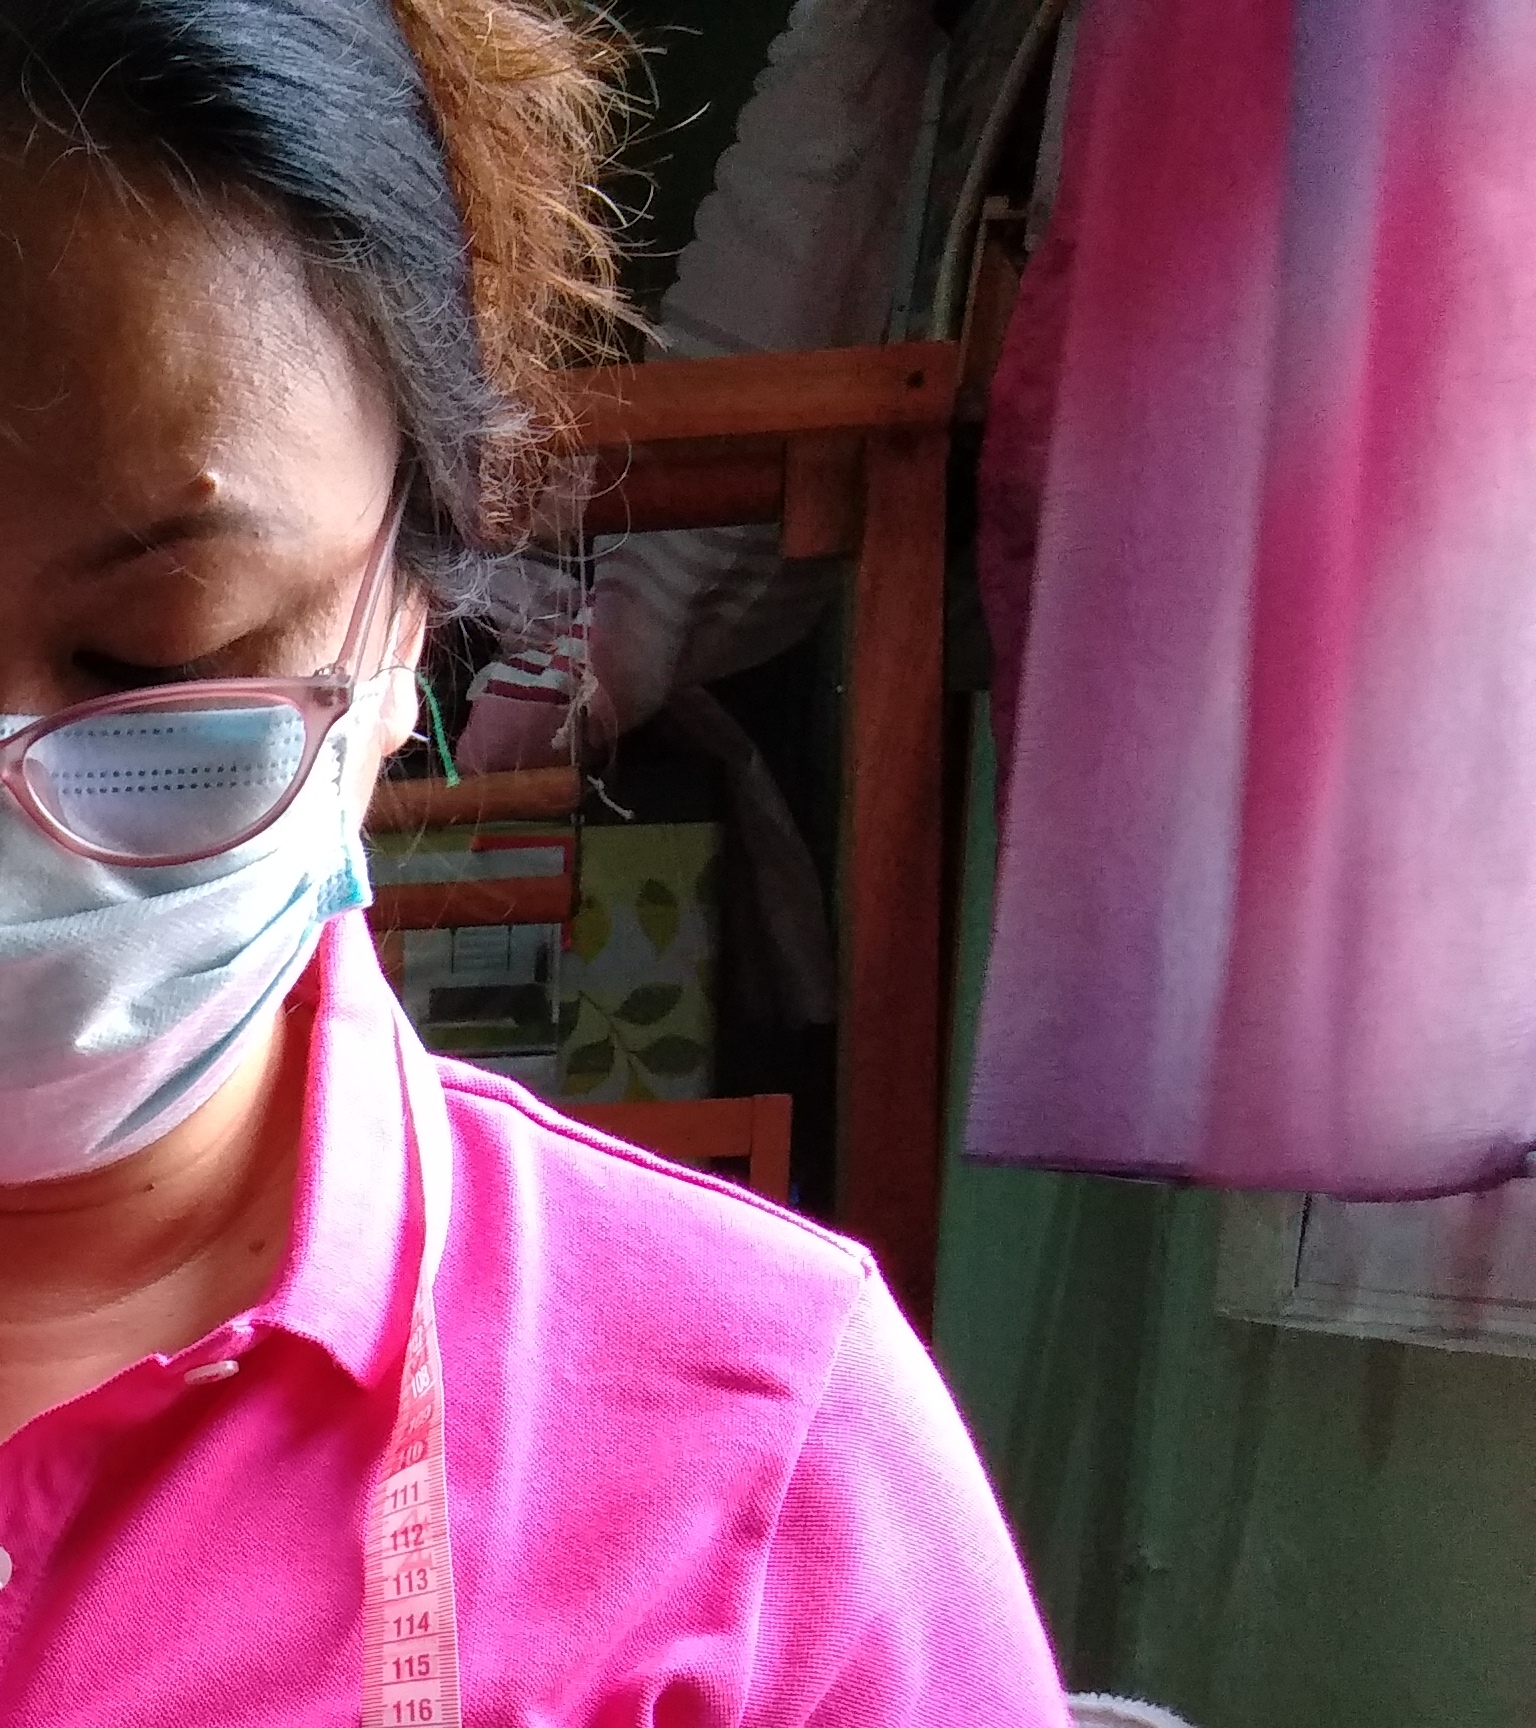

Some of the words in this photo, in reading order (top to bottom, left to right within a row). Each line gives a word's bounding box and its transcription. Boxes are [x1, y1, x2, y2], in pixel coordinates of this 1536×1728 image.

[412, 1364, 430, 1399] 108
[390, 1481, 418, 1507] 111
[390, 1523, 424, 1551] 112
[392, 1568, 428, 1595] 113
[393, 1612, 429, 1637] 114
[392, 1653, 430, 1679] 115
[392, 1698, 433, 1723] 116
